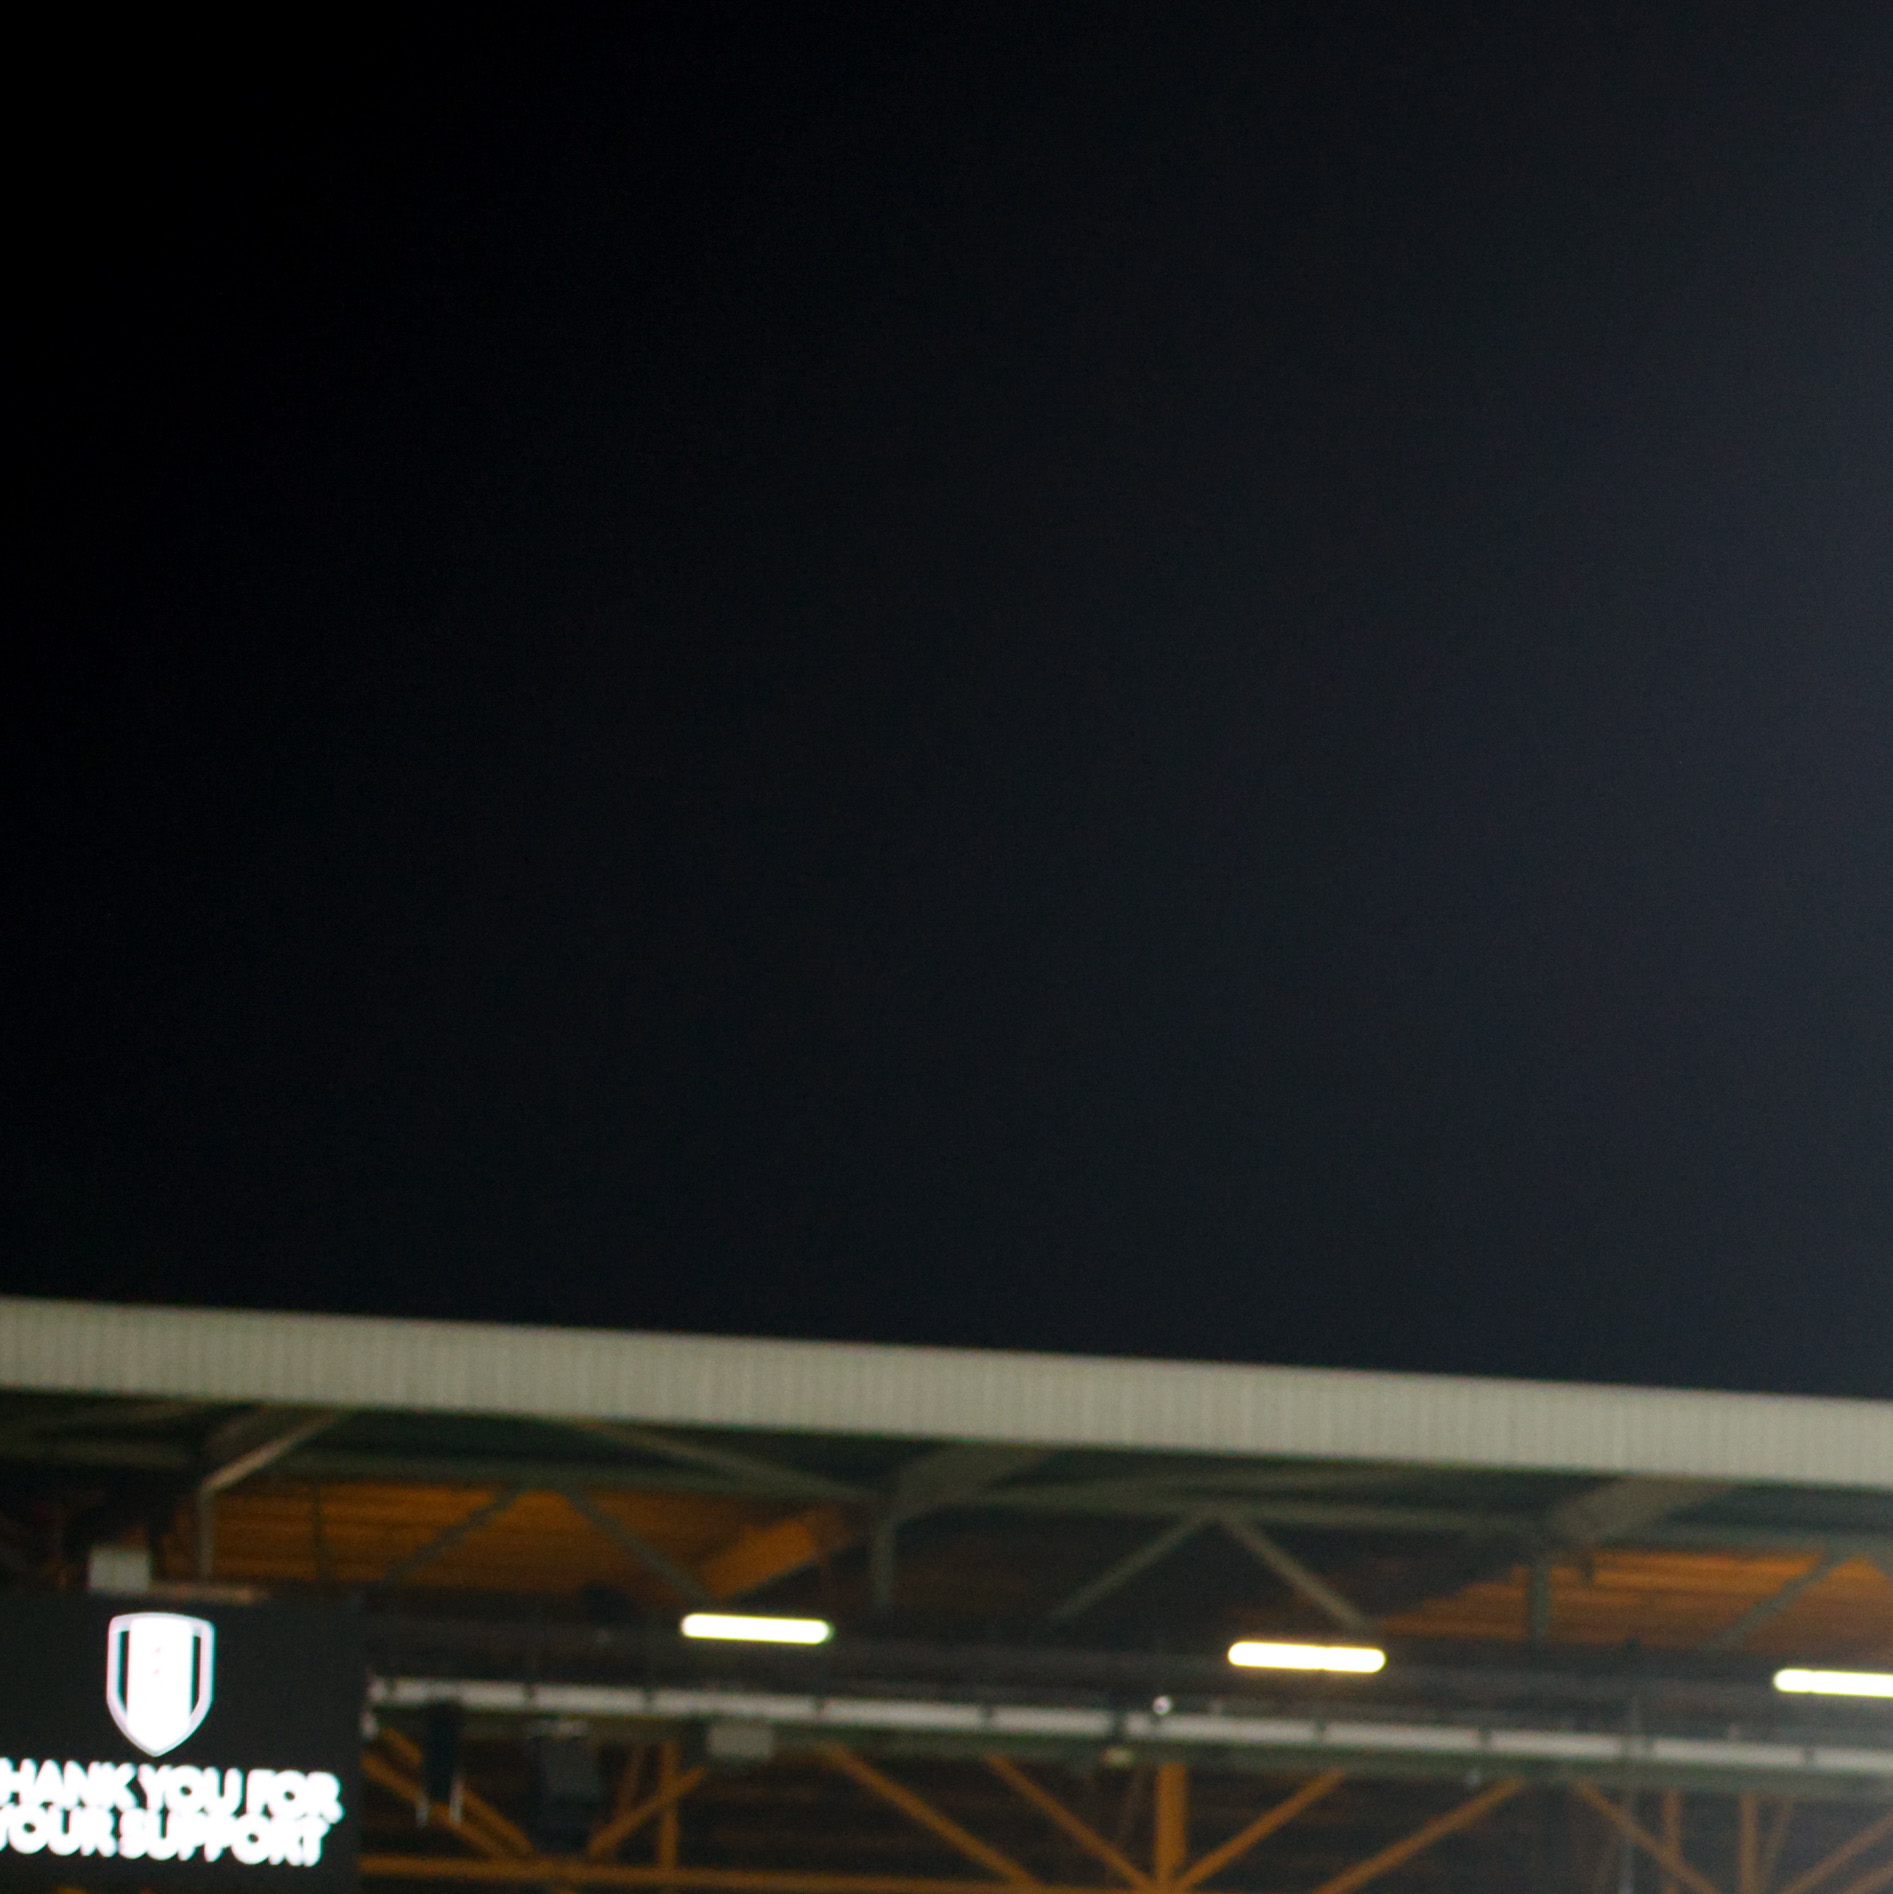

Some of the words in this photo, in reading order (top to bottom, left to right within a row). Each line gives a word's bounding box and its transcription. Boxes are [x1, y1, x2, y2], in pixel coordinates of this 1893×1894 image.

[0, 1757, 138, 1810] HANK
[138, 1764, 244, 1816] YOU
[246, 1768, 345, 1824] FOR
[118, 1808, 332, 1867] SUPPORT
